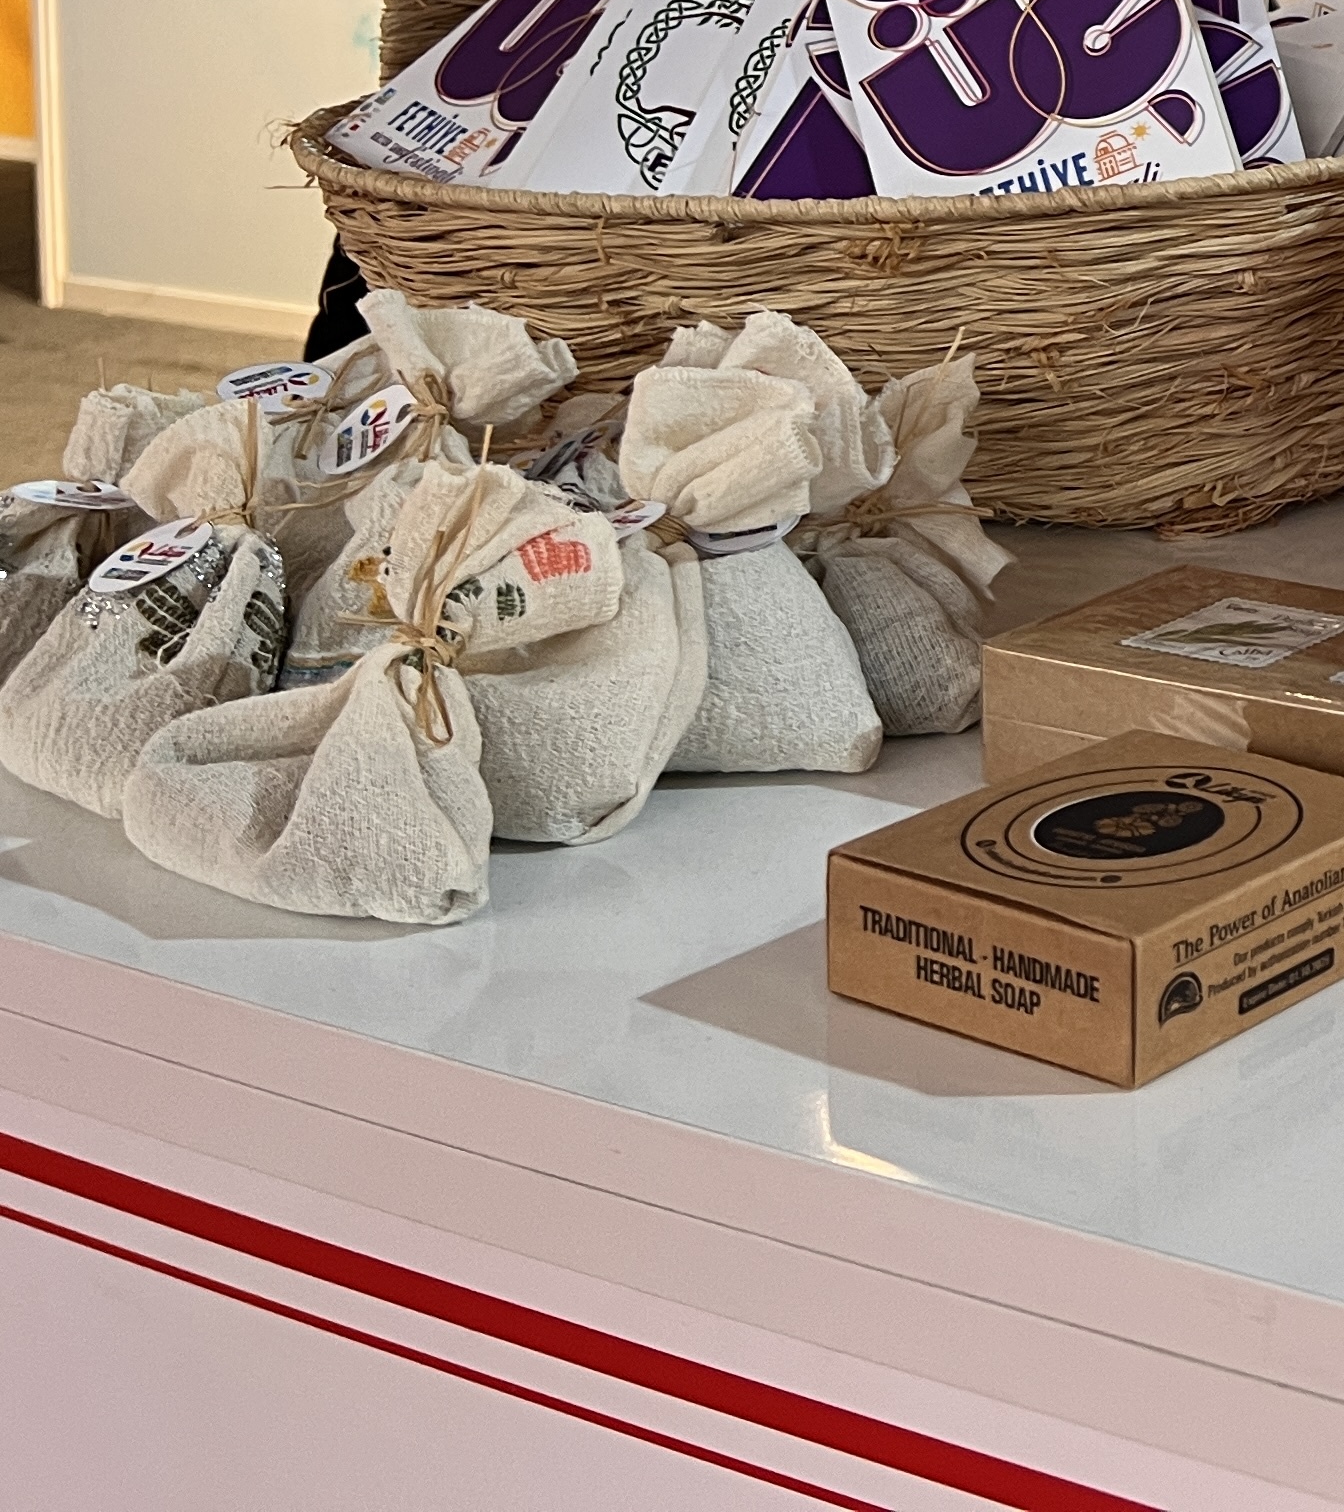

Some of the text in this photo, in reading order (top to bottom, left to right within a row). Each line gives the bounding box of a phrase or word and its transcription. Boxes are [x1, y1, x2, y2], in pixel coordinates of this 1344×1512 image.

[860, 905, 977, 964] TRADITIONAL
[992, 945, 1100, 1003] HANDMADE
[1172, 937, 1204, 963] The
[1209, 910, 1257, 947] Power
[1261, 896, 1278, 920] of
[916, 954, 1041, 1015] HERBAL SOAP
